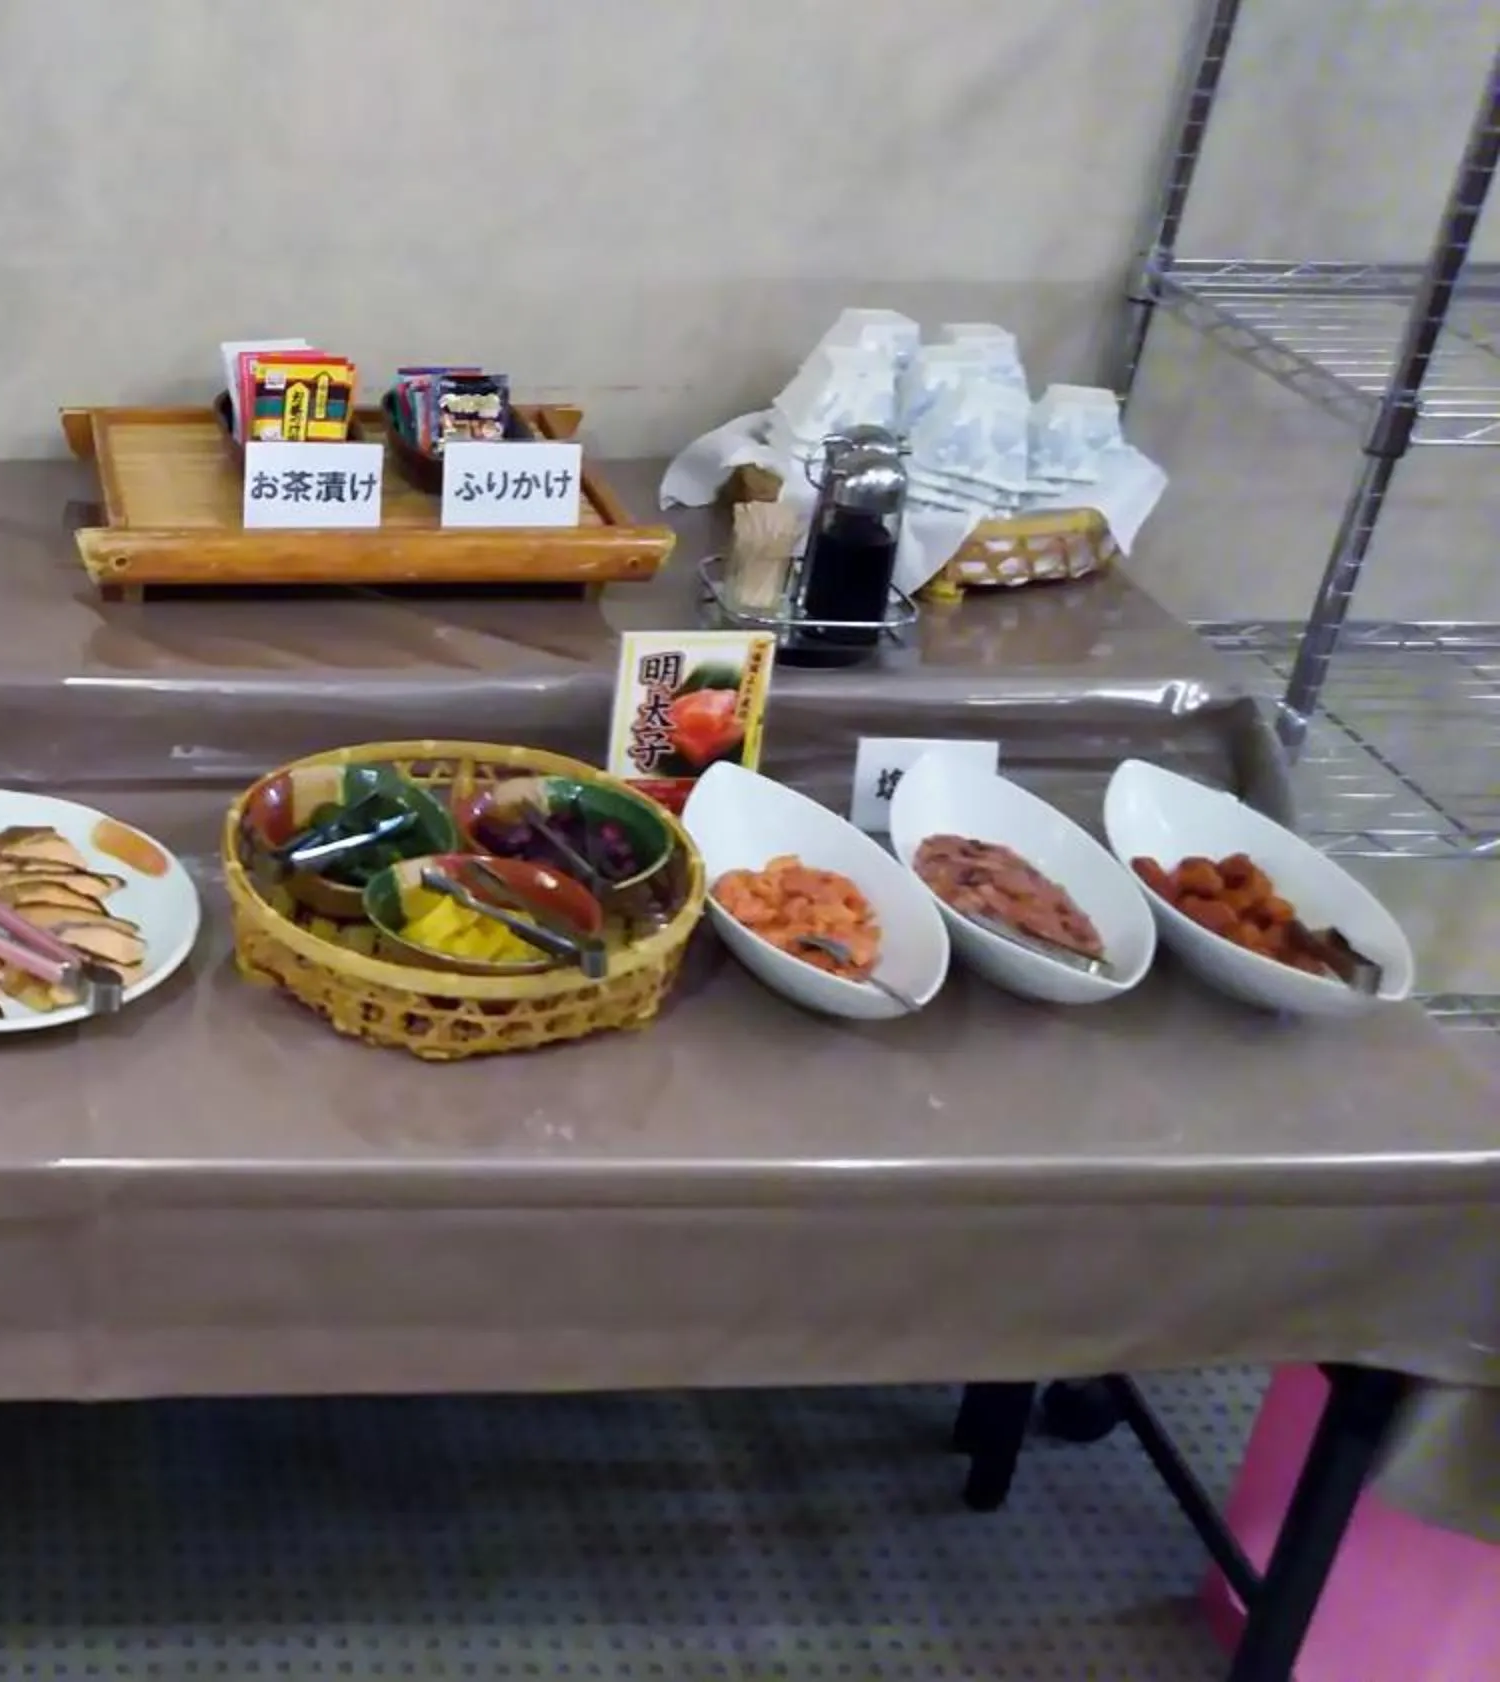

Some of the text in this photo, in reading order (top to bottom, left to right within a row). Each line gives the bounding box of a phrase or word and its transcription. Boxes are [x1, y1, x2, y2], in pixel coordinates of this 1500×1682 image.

[250, 470, 377, 502] お茶漬け
[454, 469, 573, 501] ふりかけ
[630, 653, 684, 770] 明太子
